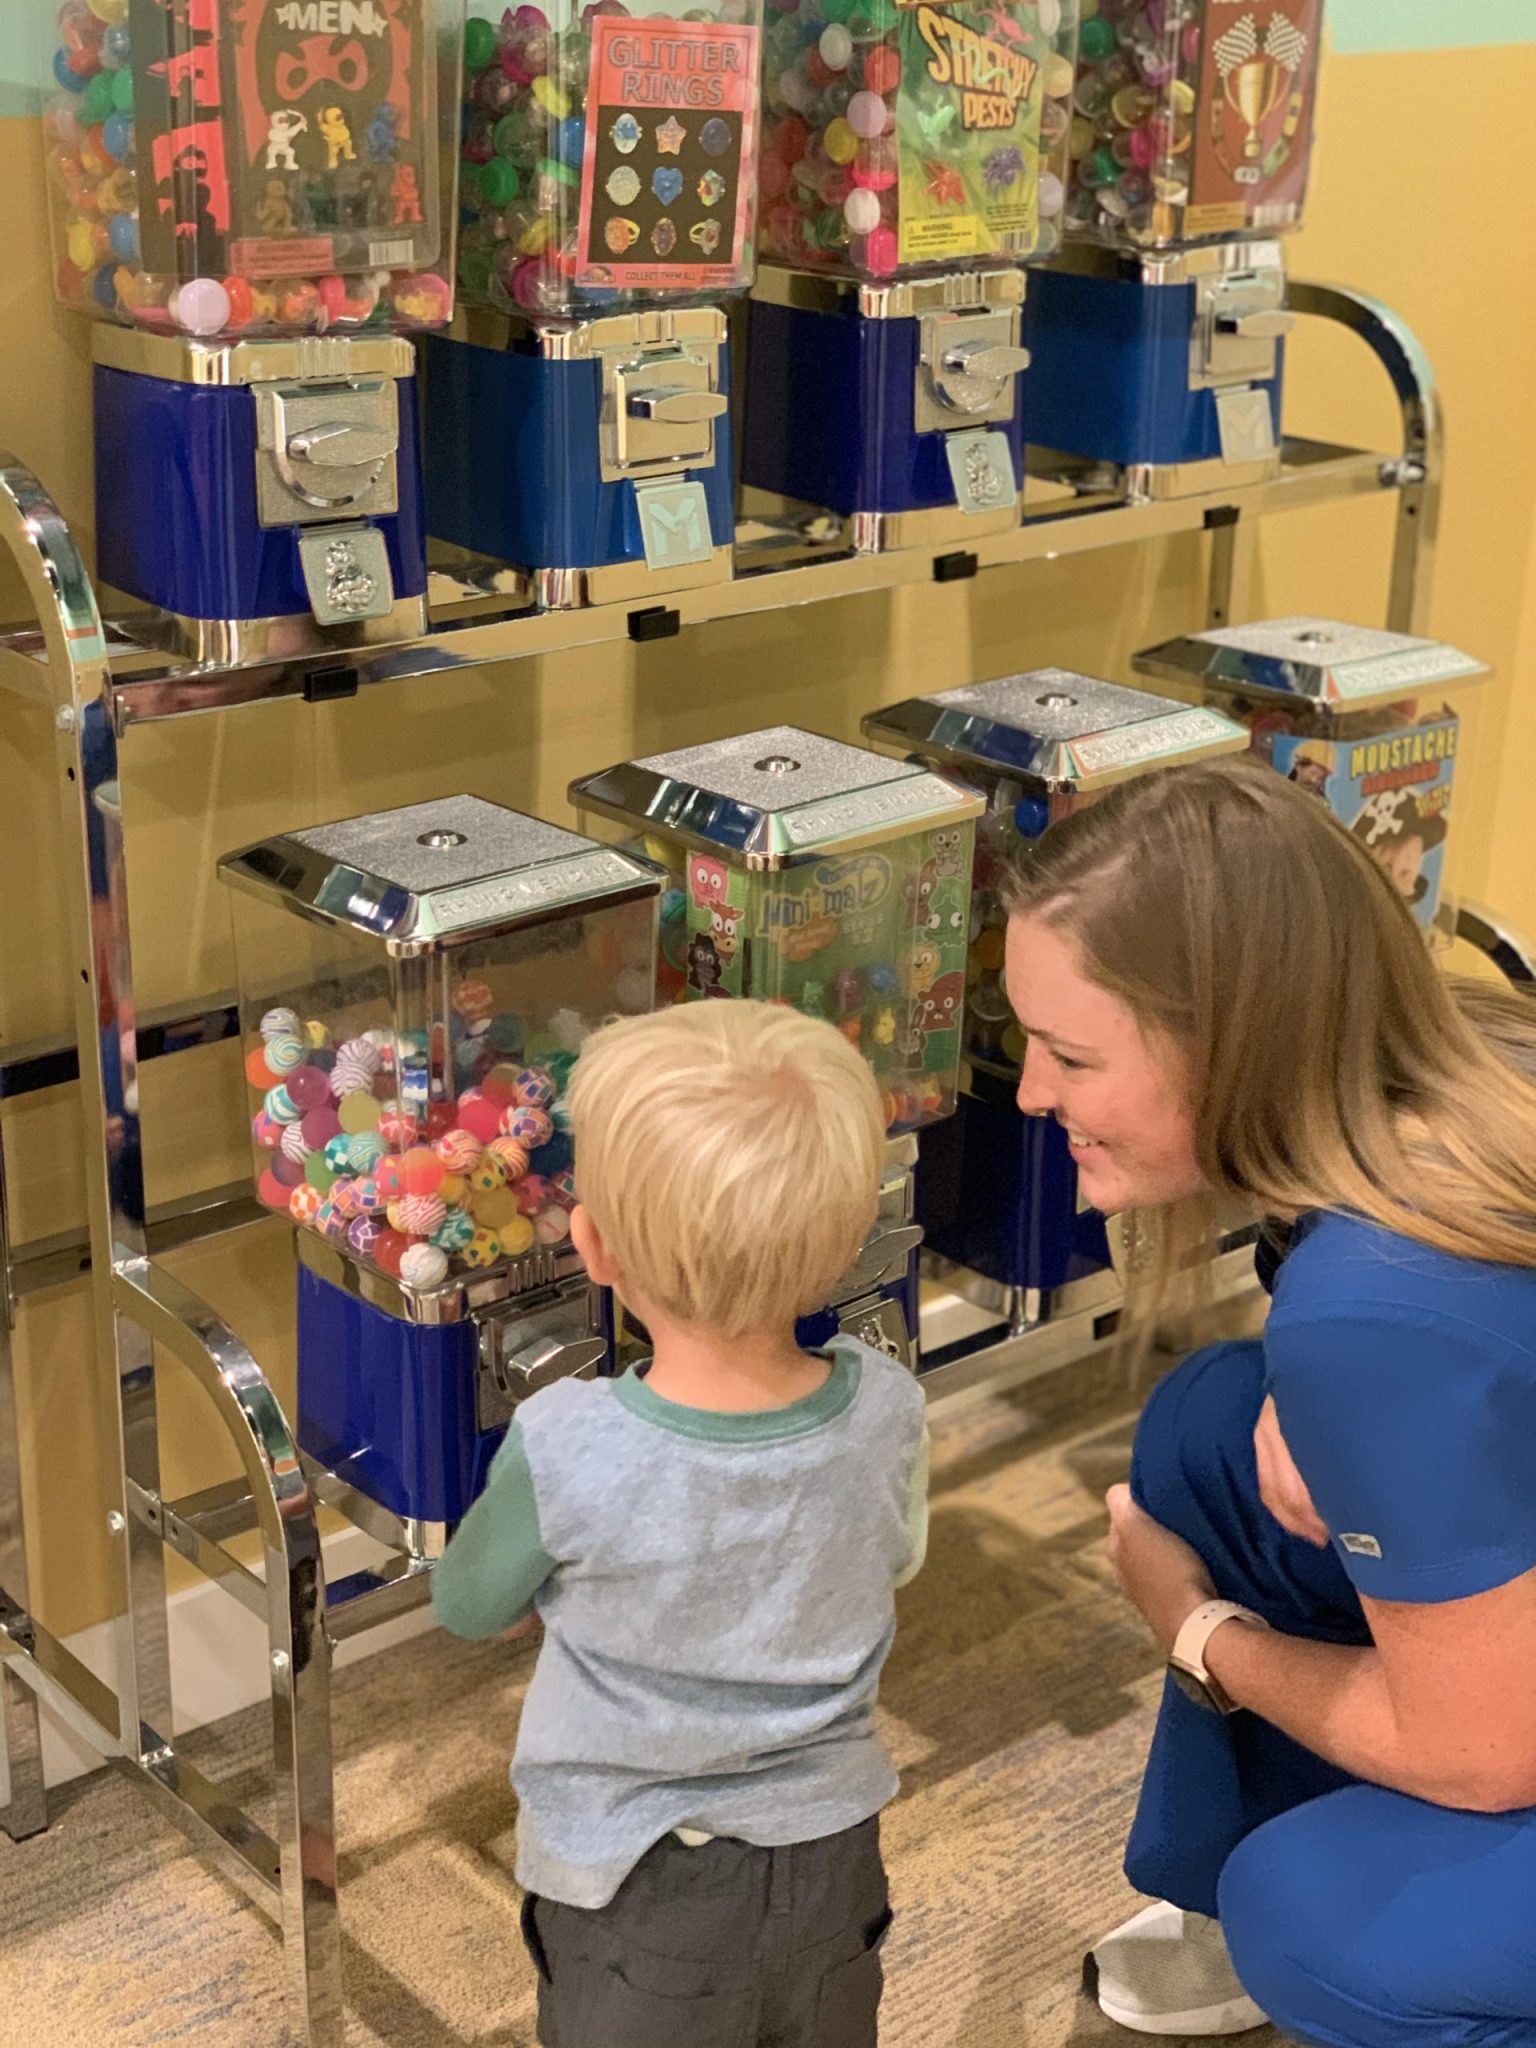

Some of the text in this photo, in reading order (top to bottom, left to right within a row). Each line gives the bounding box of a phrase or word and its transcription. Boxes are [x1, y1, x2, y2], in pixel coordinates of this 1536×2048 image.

[287, 0, 374, 35] MEN
[608, 35, 741, 73] GLITTER
[915, 5, 1038, 99] STRETCHY
[622, 71, 725, 105] RINGS
[962, 91, 1017, 130] PESTS
[625, 271, 658, 281] COLLECT
[661, 271, 682, 281] THEM
[683, 270, 697, 281] ALL
[1350, 727, 1456, 779] MOUSTACHE
